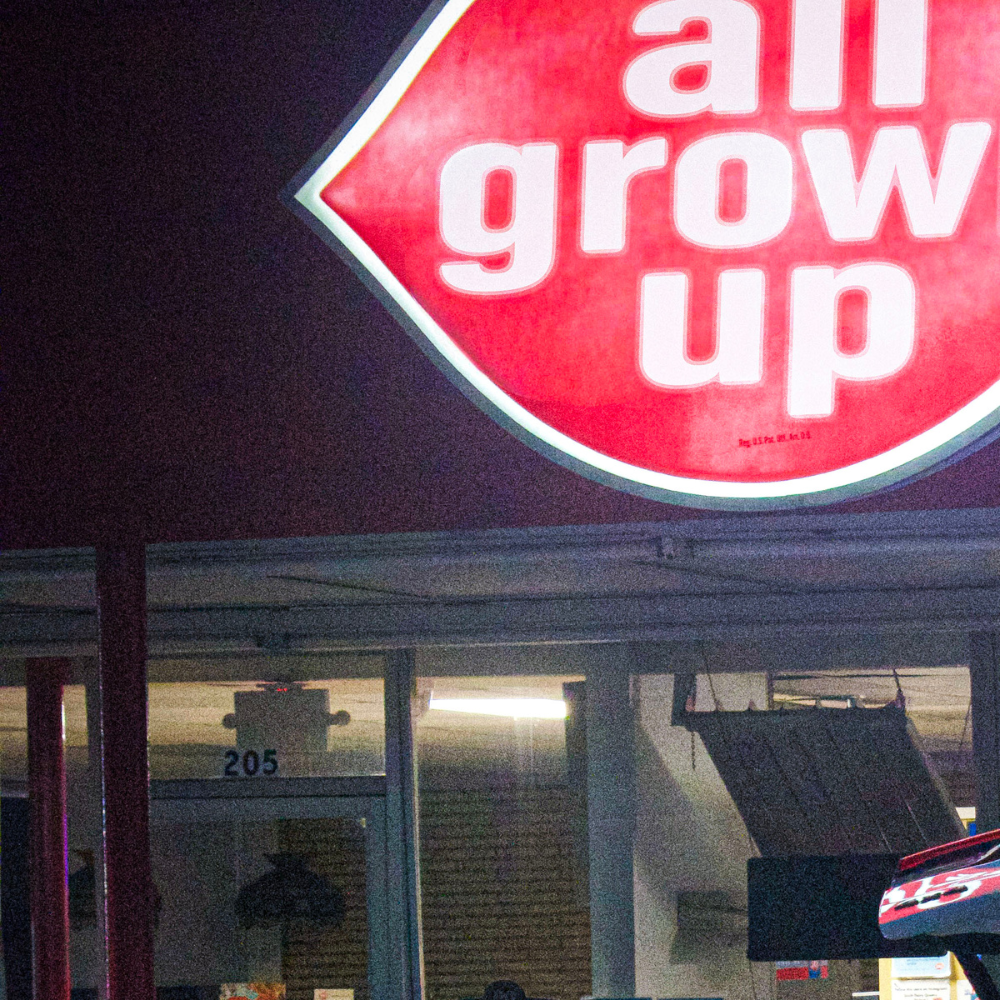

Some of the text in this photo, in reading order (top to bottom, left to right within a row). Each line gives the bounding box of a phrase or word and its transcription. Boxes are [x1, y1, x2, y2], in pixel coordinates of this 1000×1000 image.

[624, 0, 928, 116] all
[637, 262, 918, 419] up
[224, 749, 278, 776] 205
